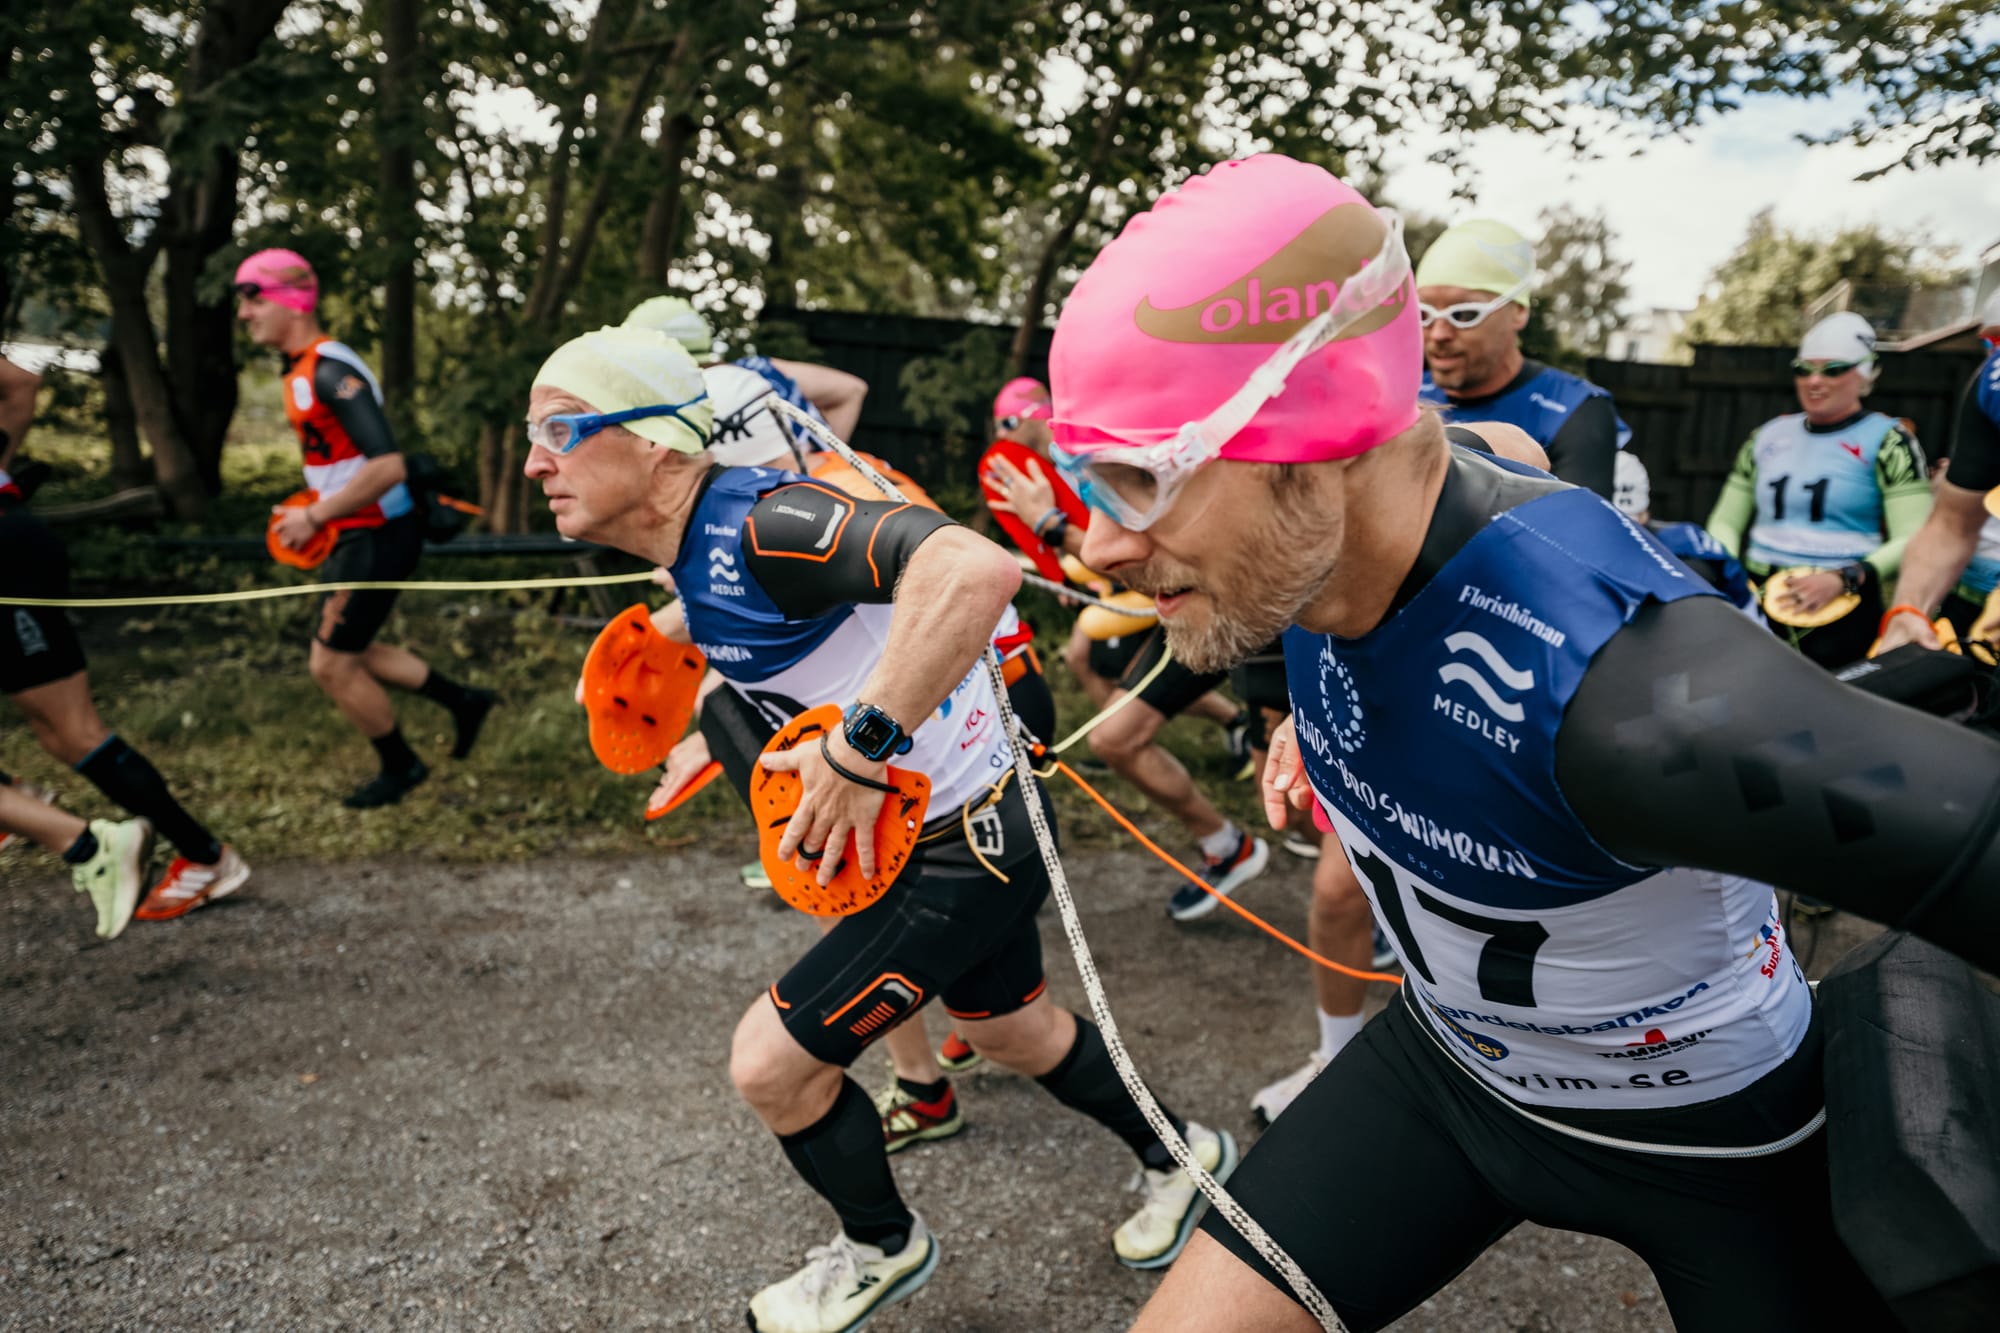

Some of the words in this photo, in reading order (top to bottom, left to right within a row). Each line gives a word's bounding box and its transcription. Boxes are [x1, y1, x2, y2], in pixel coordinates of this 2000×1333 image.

[1769, 475, 1829, 522] 11
[710, 583, 746, 596] MEDLEY
[1458, 584, 1566, 648] Floristhörnan
[1433, 693, 1521, 754] MEDLEY
[1380, 793, 1537, 879] SWIMRUN
[1350, 845, 1550, 1008] 17
